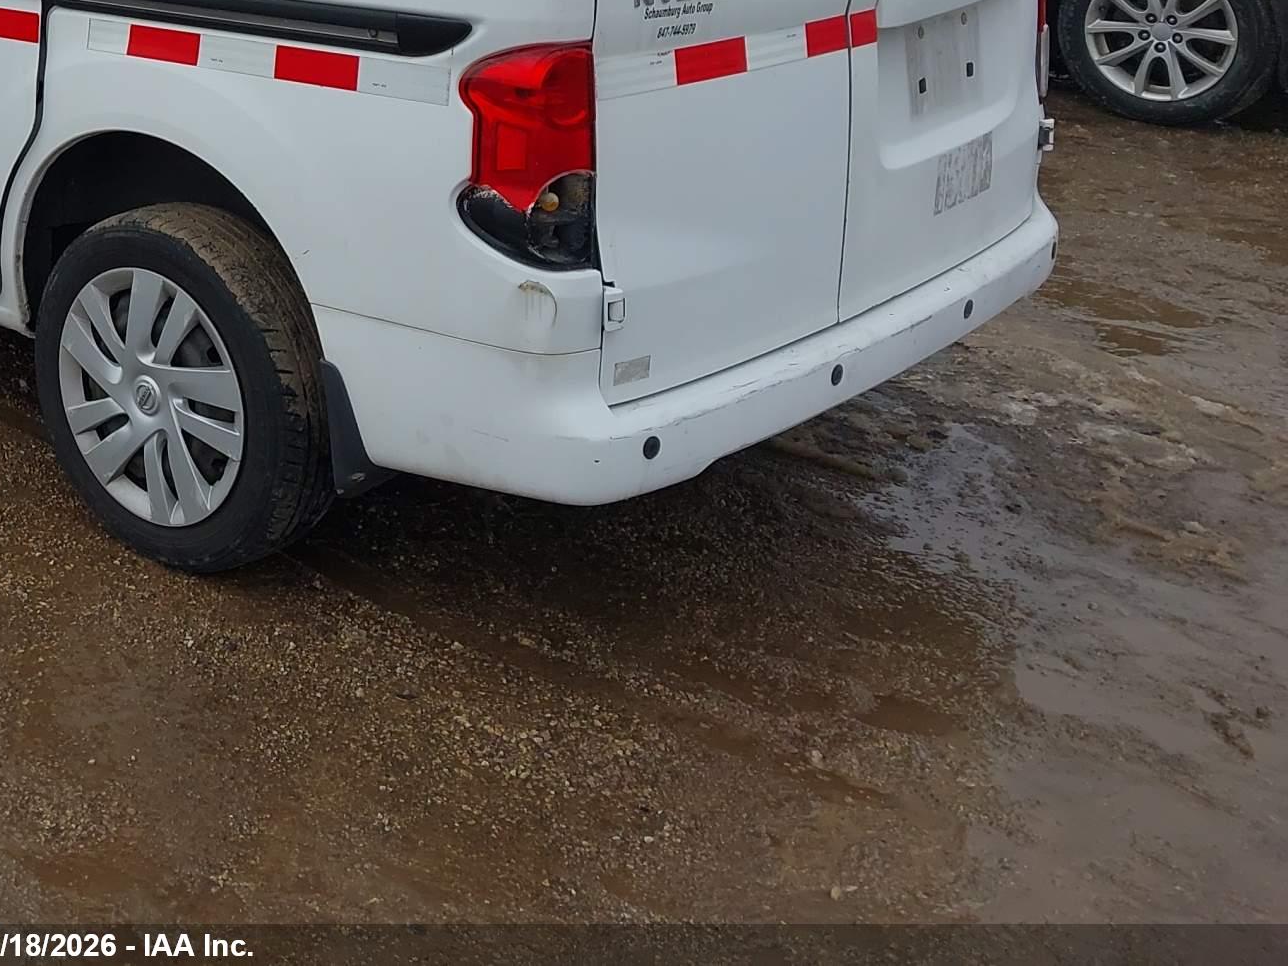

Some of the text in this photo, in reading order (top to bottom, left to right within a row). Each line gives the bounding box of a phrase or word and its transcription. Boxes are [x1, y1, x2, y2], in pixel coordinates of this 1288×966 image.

[644, 1, 714, 20] Schaumburg Auto Group
